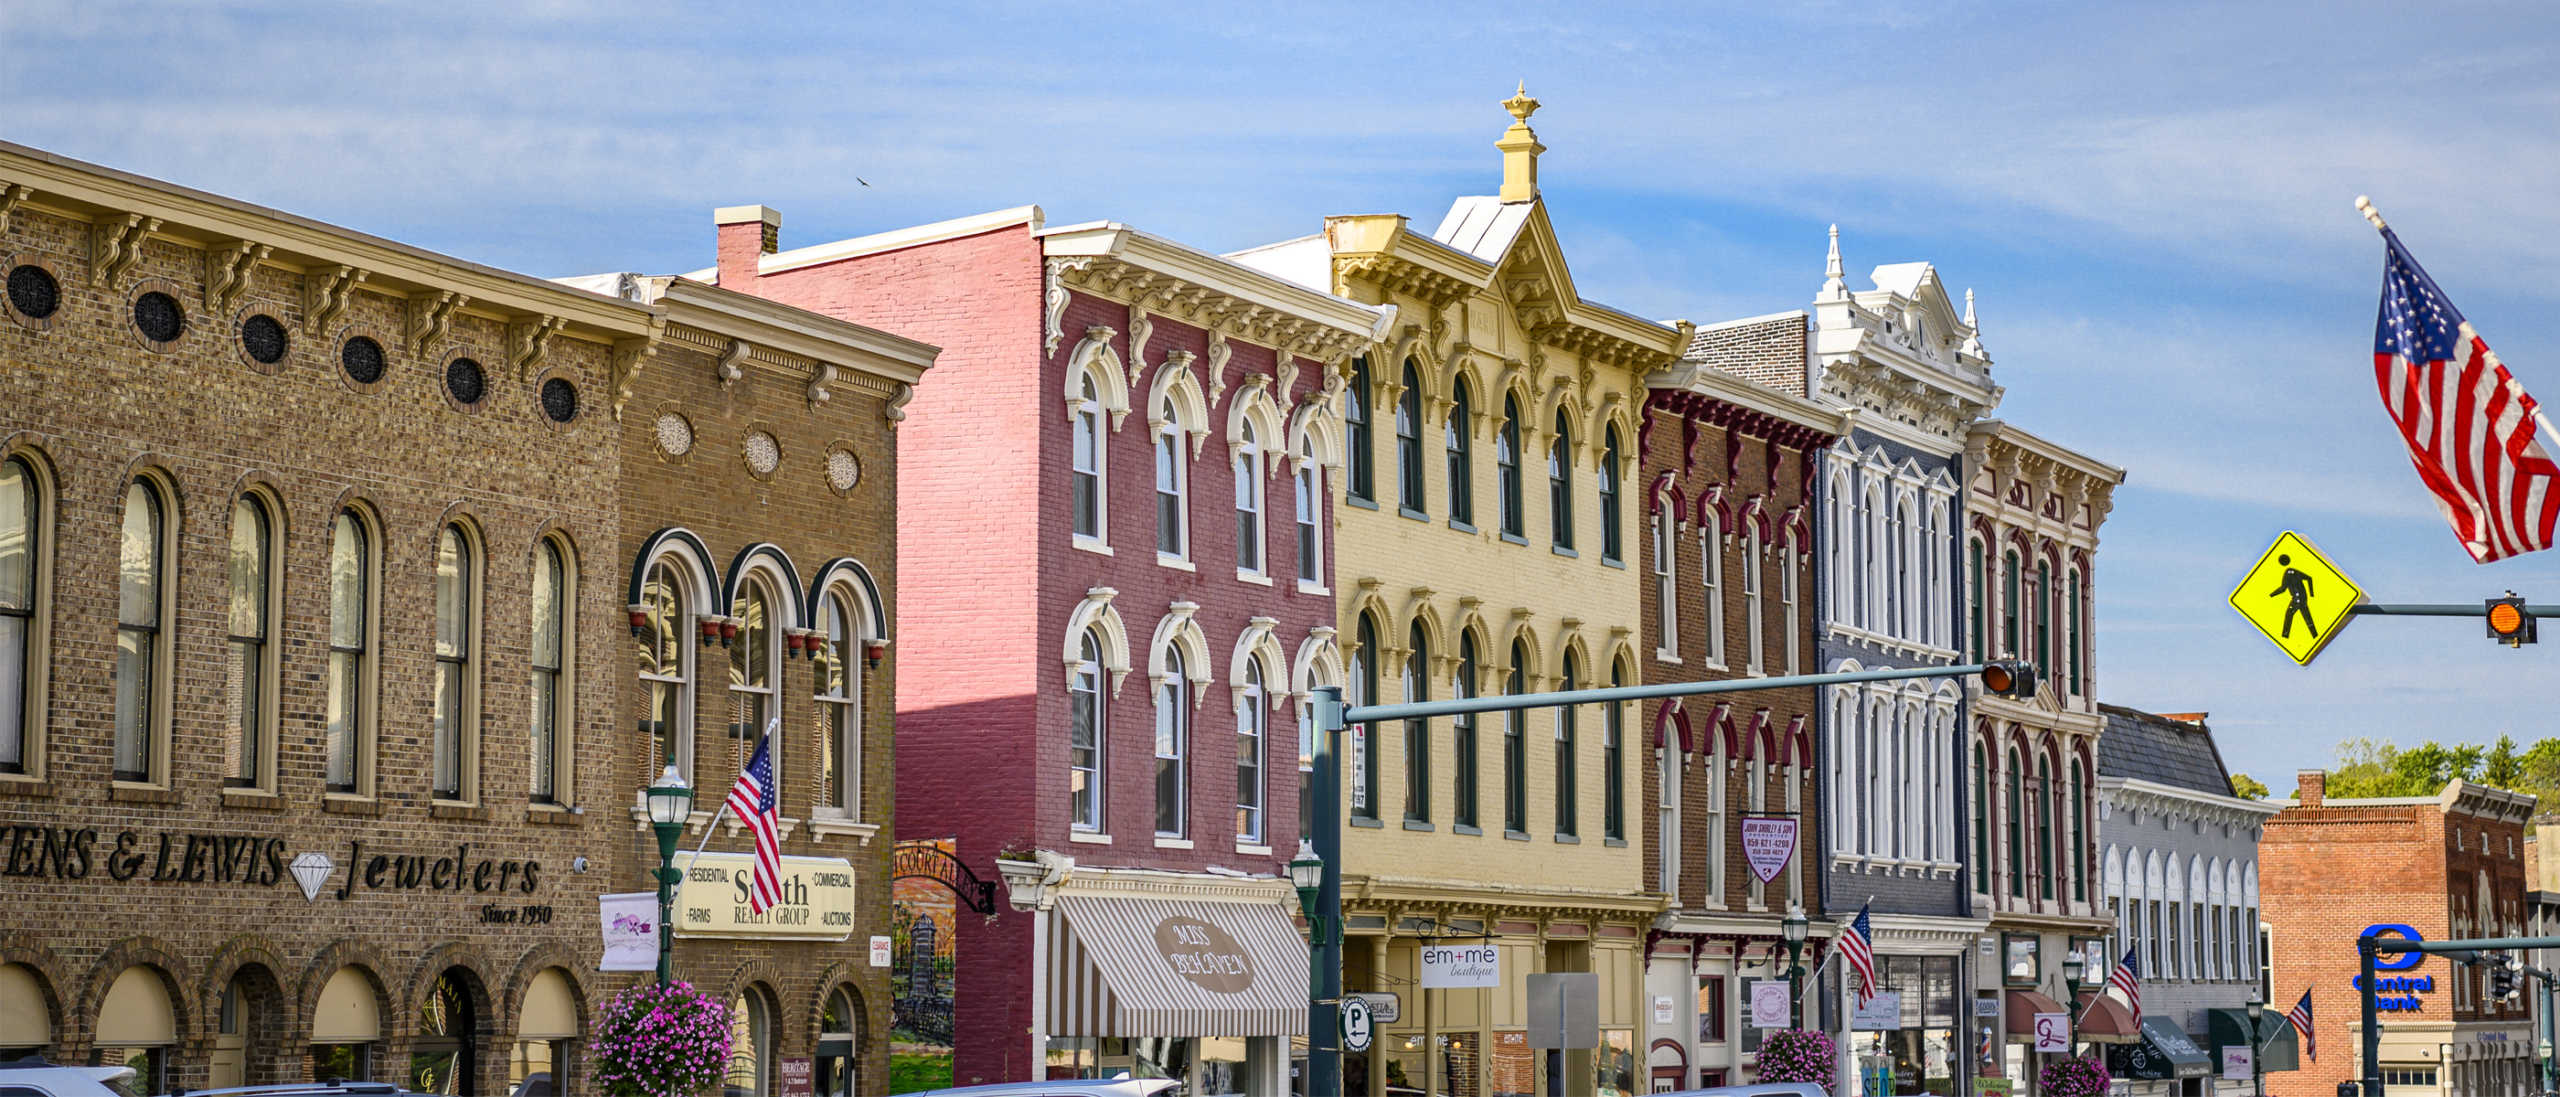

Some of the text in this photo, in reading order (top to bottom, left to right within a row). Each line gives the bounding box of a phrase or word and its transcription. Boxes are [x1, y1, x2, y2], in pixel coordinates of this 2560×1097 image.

[0, 825, 541, 900] ENS & LEWIS Jewelers
[900, 852, 939, 876] COURT
[689, 867, 729, 883] RESIDENTIAL
[813, 872, 852, 888] COMMERCIAL
[734, 869, 809, 906] Sth
[480, 903, 553, 926] Since 1950
[776, 907, 809, 925] GROUP
[823, 911, 851, 926] AUCTIONS
[1172, 924, 1211, 946] MISS
[1170, 951, 1249, 975] BEHAVEN
[1424, 949, 1495, 964] em+me
[1449, 963, 1494, 981] boutique
[1351, 1009, 1361, 1028] P
